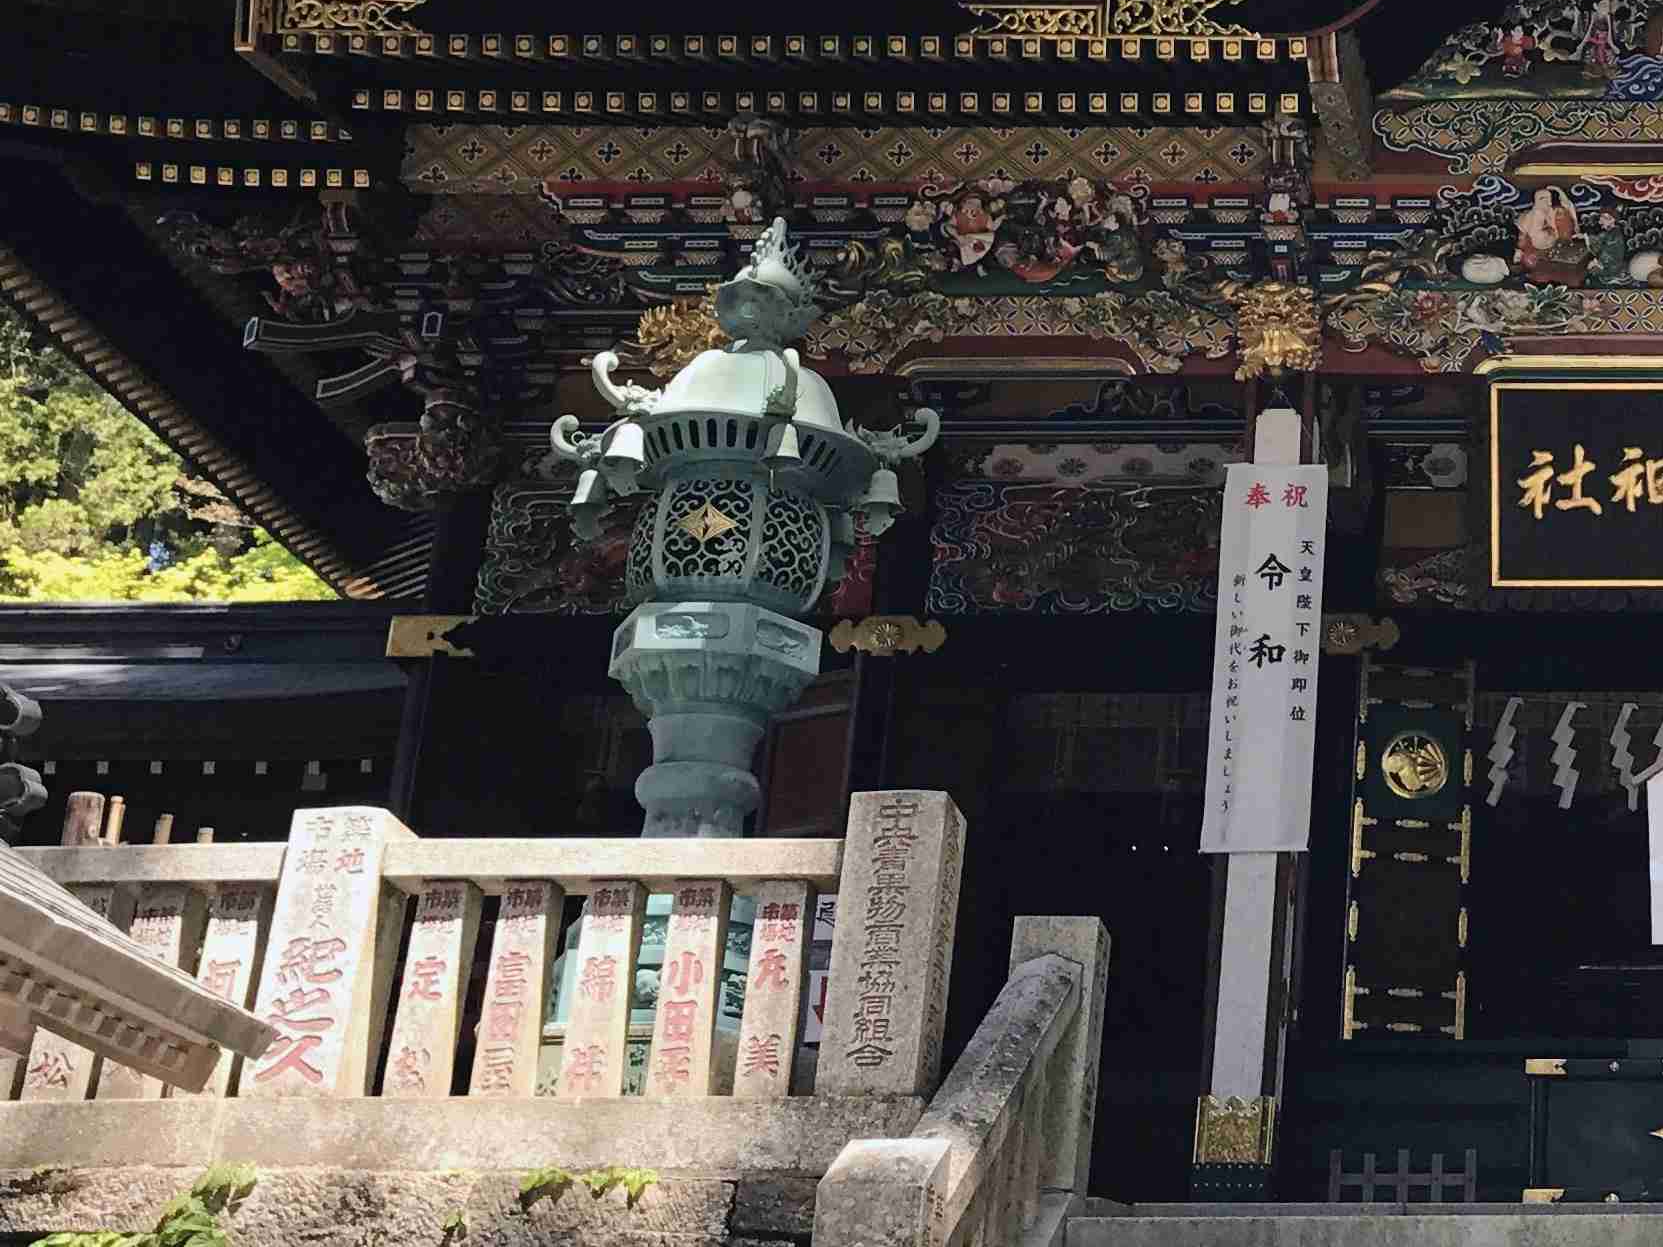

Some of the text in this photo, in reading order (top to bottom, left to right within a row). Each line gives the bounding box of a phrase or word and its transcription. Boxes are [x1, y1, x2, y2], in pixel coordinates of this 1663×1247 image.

[1245, 482, 1309, 509] 奉祝
[1247, 553, 1292, 669] 令和
[1289, 540, 1315, 721] 天皇陛下御即位
[846, 798, 919, 1067] 中央青果物商業協同組合
